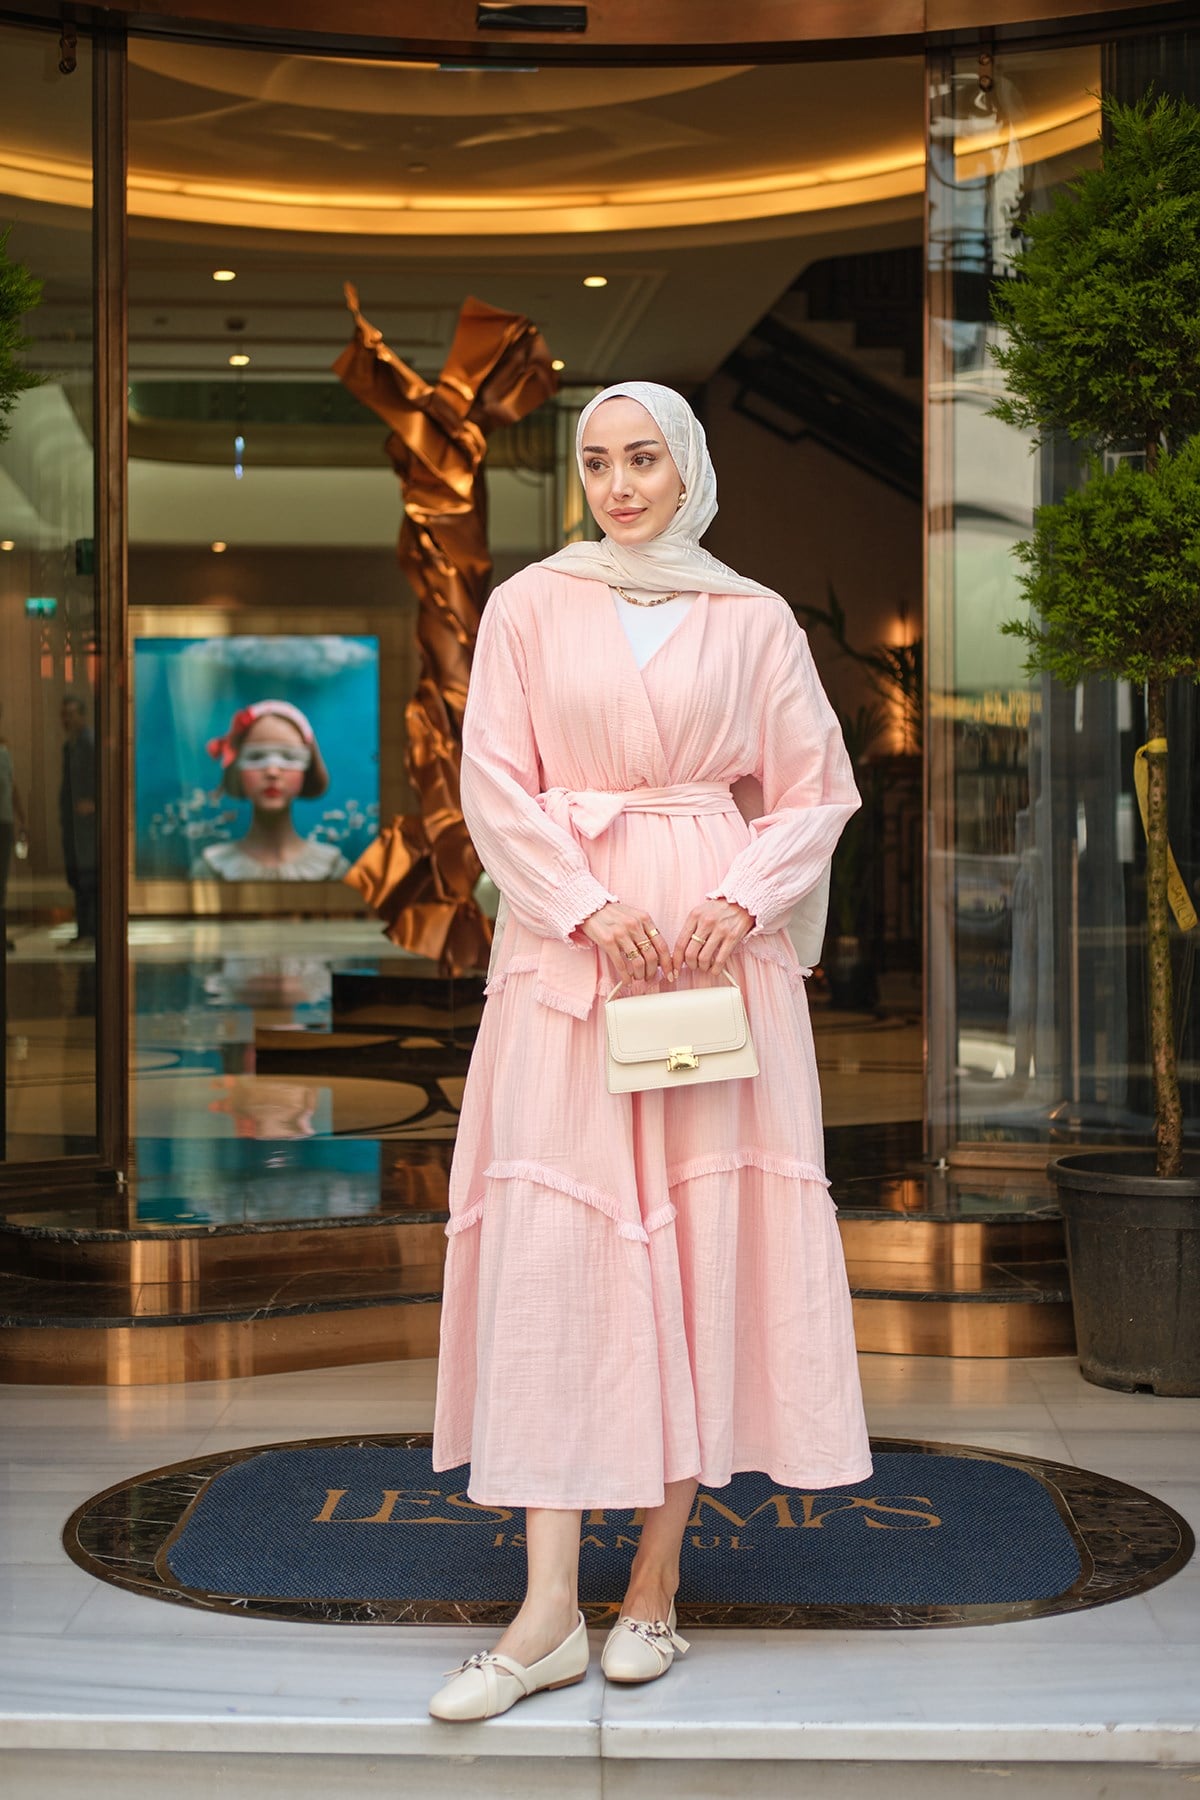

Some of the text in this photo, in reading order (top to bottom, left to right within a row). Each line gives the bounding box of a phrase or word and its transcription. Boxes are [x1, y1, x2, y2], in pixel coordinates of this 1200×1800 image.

[312, 1489, 942, 1529] LES MPS
[493, 1533, 755, 1550] ISANUL
